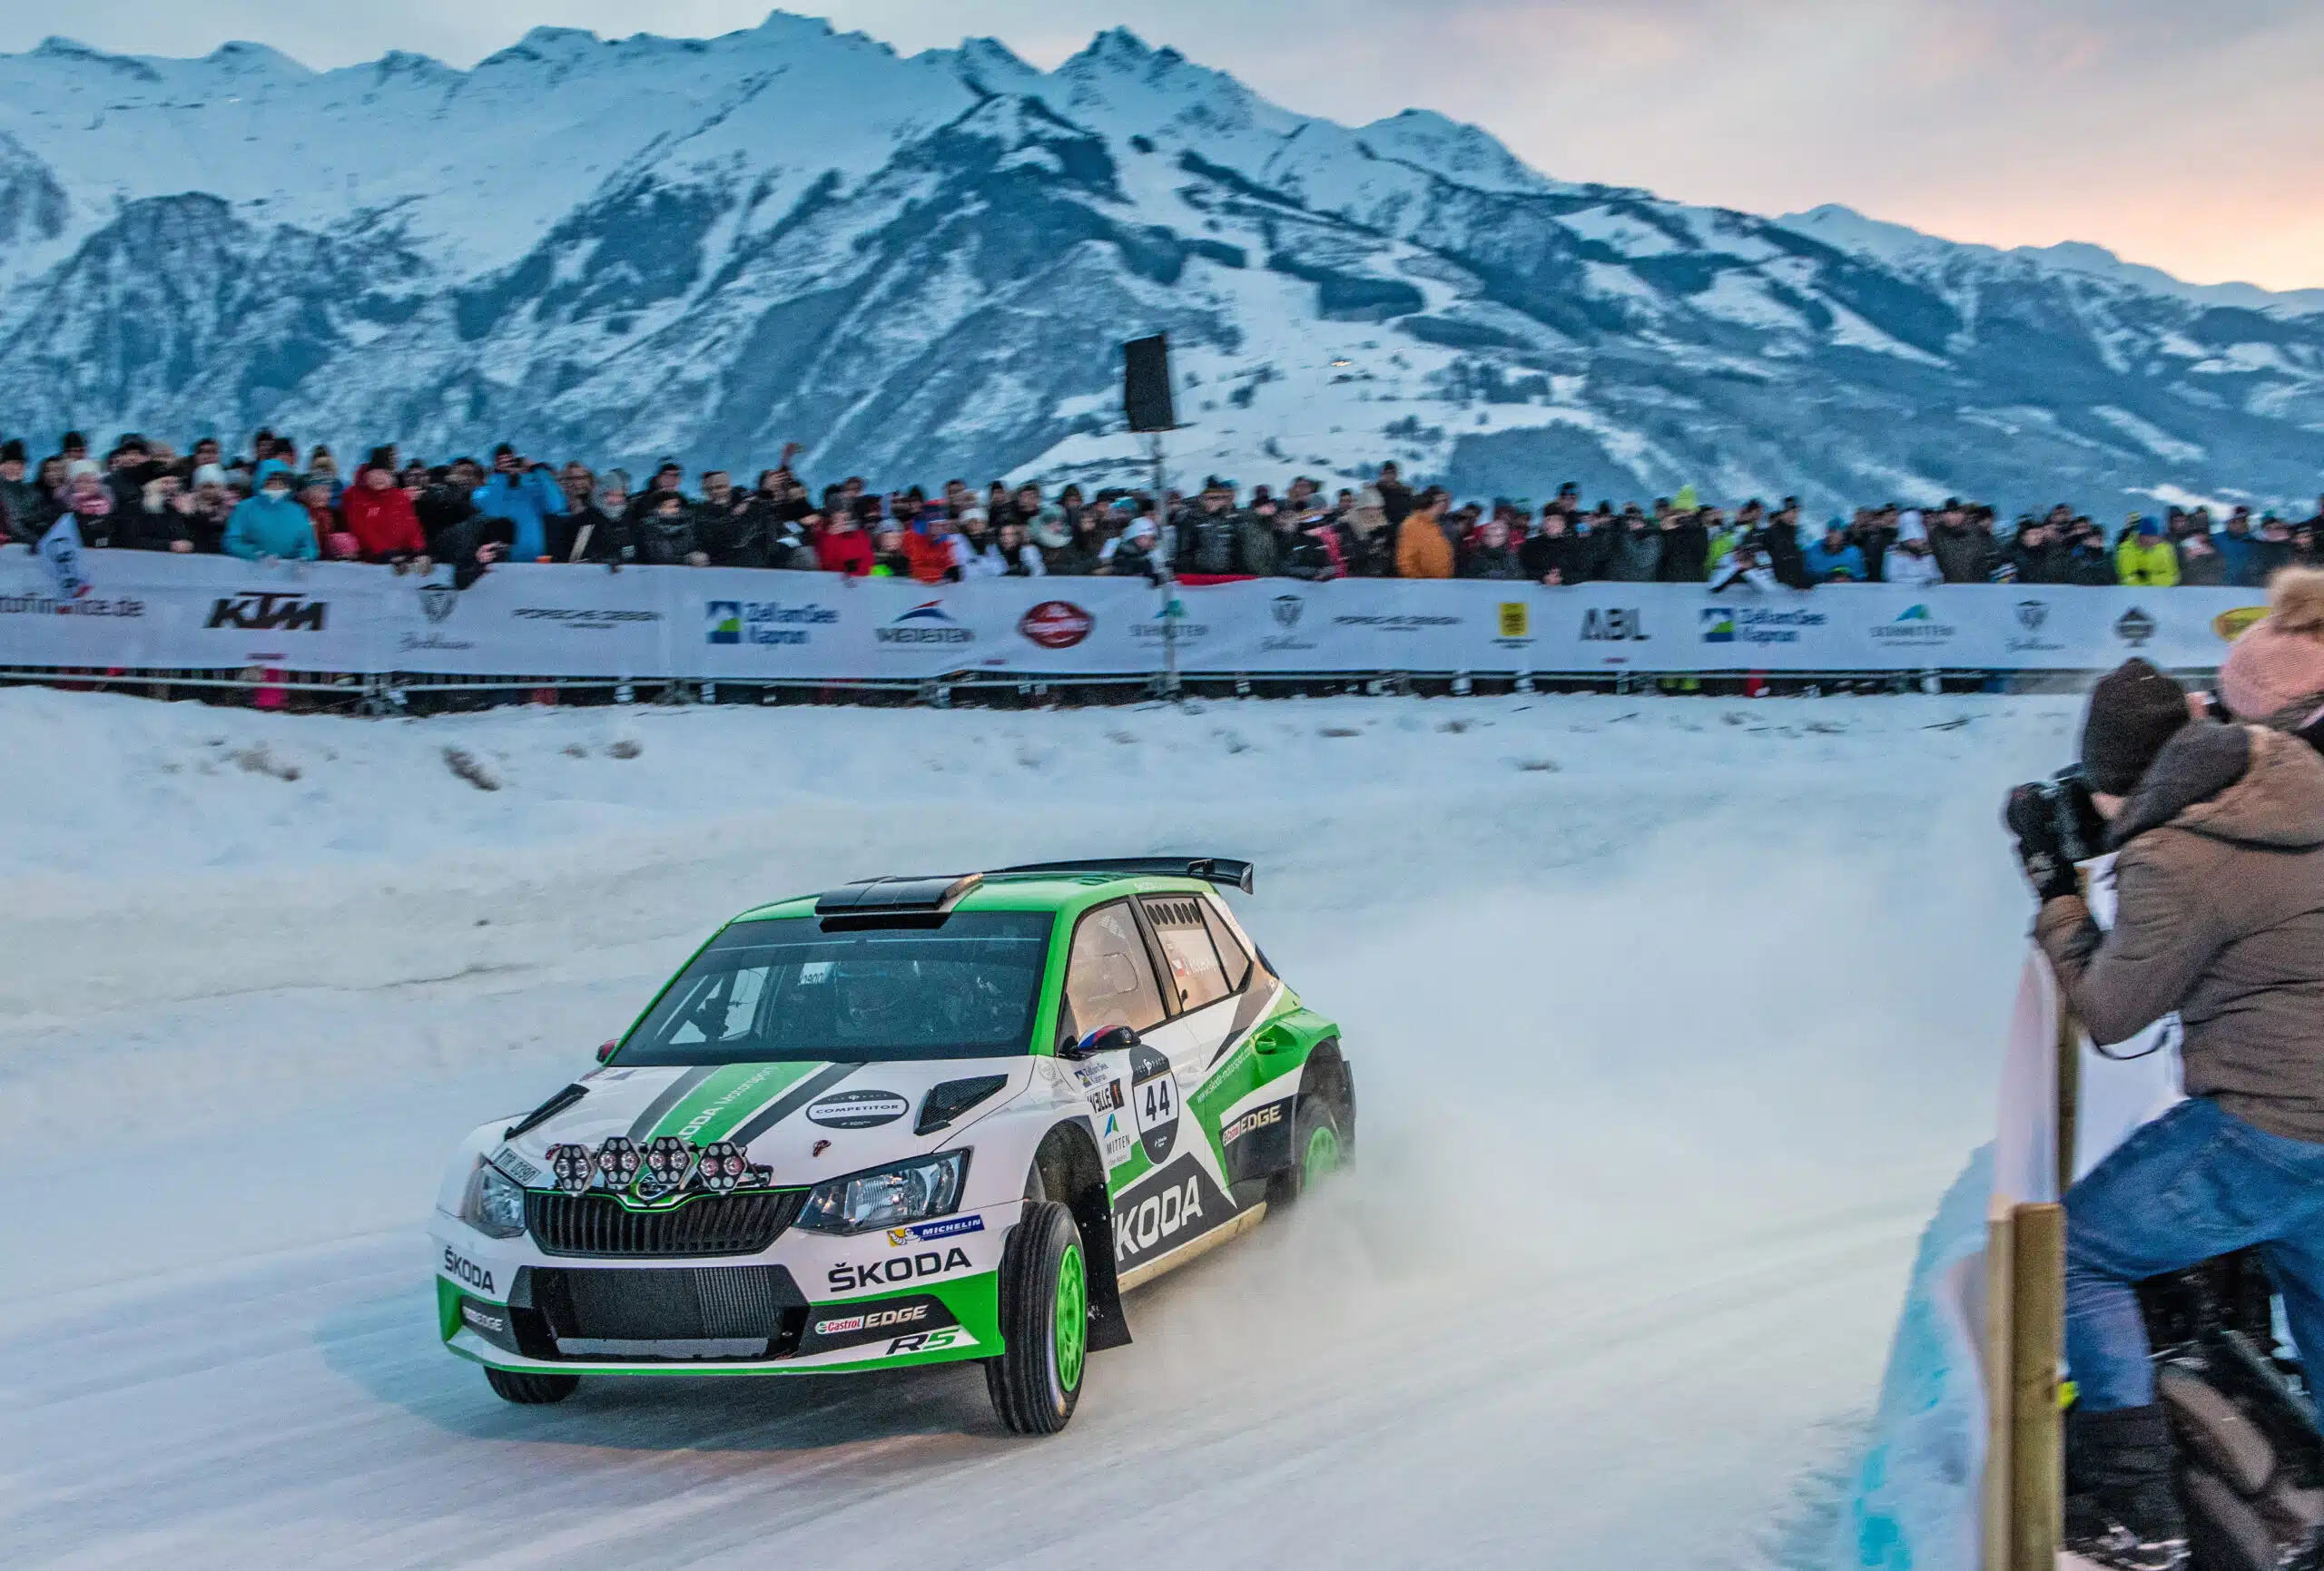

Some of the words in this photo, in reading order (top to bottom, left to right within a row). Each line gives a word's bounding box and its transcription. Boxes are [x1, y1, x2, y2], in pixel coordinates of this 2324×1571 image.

[202, 591, 330, 631] KTM
[815, 1104, 900, 1114] COMPETITOR
[1146, 1080, 1170, 1122] 44
[1240, 1104, 1282, 1134] EDGE
[510, 1161, 537, 1183] 0390
[922, 1218, 981, 1236] MICHELIN
[1111, 1174, 1203, 1262] KODA
[445, 1244, 496, 1295] ŠKODA
[828, 1247, 972, 1293] ŠKODA
[476, 1312, 503, 1332] EDGE
[827, 1318, 862, 1332] Castrol
[864, 1304, 930, 1330] EDGE
[886, 1328, 960, 1356] R5
